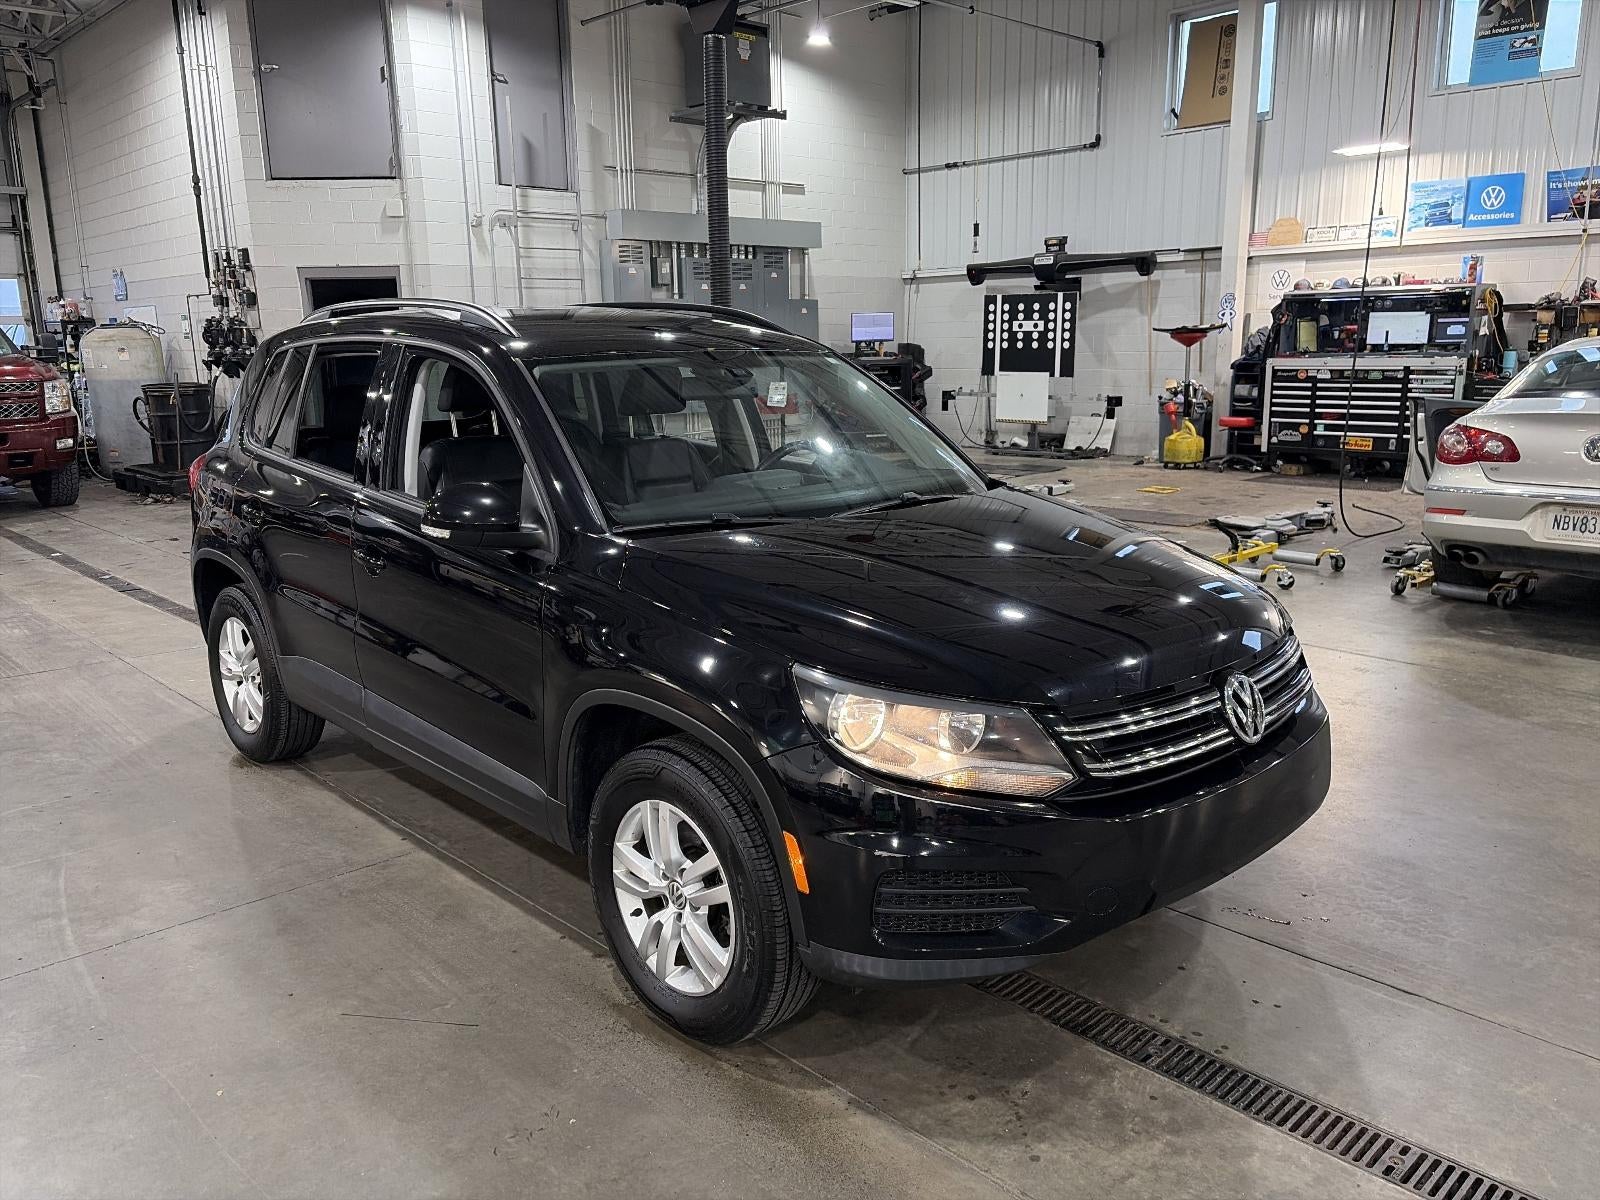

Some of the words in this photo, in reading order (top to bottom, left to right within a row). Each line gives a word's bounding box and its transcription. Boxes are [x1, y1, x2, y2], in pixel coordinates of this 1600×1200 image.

[1491, 26, 1510, 35] keeps
[1520, 21, 1540, 31] giving
[1549, 181, 1563, 189] It's
[1468, 212, 1514, 221] Accessories
[1552, 514, 1600, 535] NBV83
